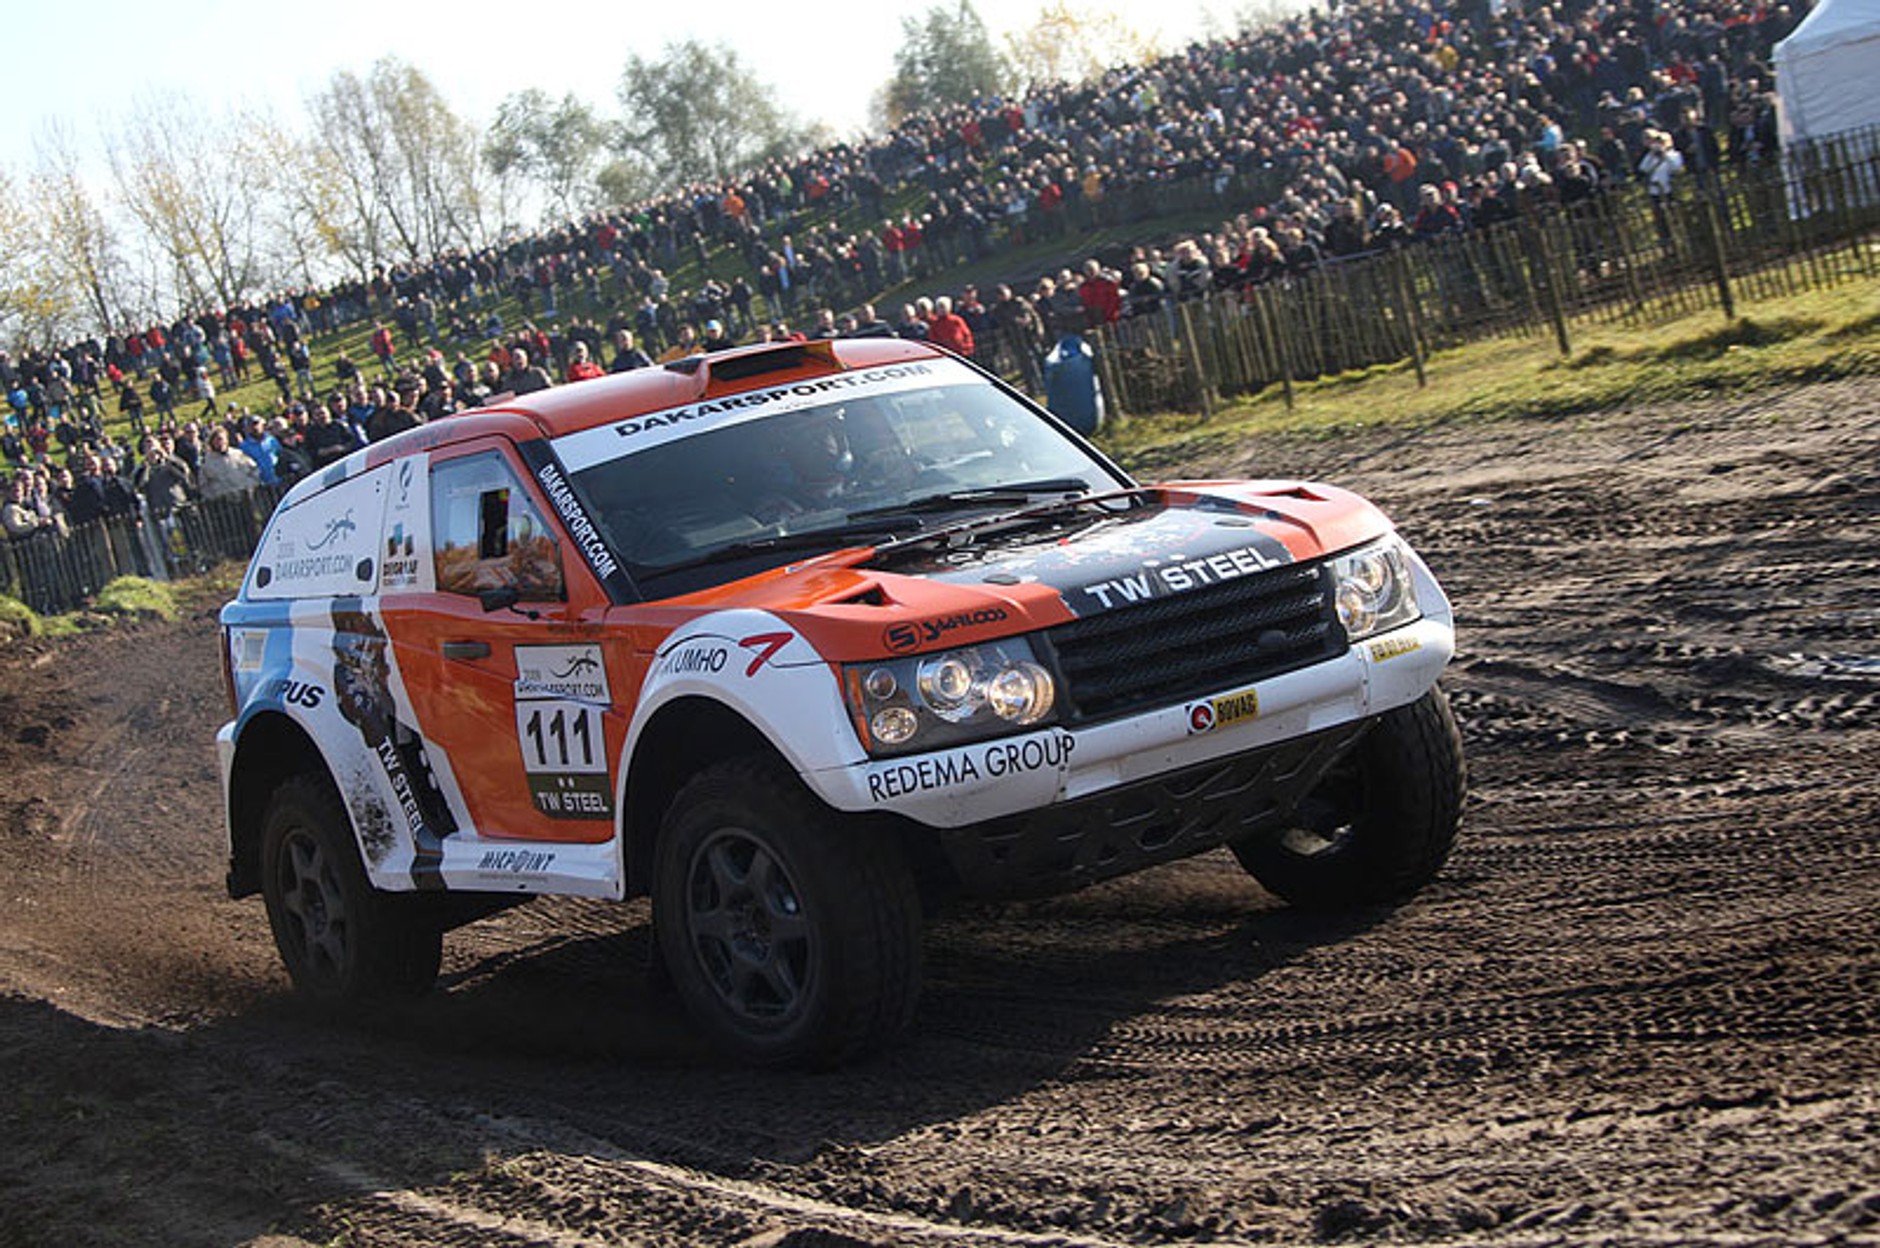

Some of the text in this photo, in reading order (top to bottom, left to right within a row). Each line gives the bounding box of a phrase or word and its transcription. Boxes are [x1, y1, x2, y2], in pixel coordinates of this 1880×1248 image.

[615, 363, 932, 438] DAKARSPORT.COM
[538, 463, 620, 581] DAKARSPORT.COM
[1085, 546, 1282, 609] TW STEEL
[526, 708, 594, 766] 111
[868, 734, 1076, 802] REDEMA GROUP
[377, 736, 426, 837] TW STEEL
[537, 792, 609, 813] TW STEEL
